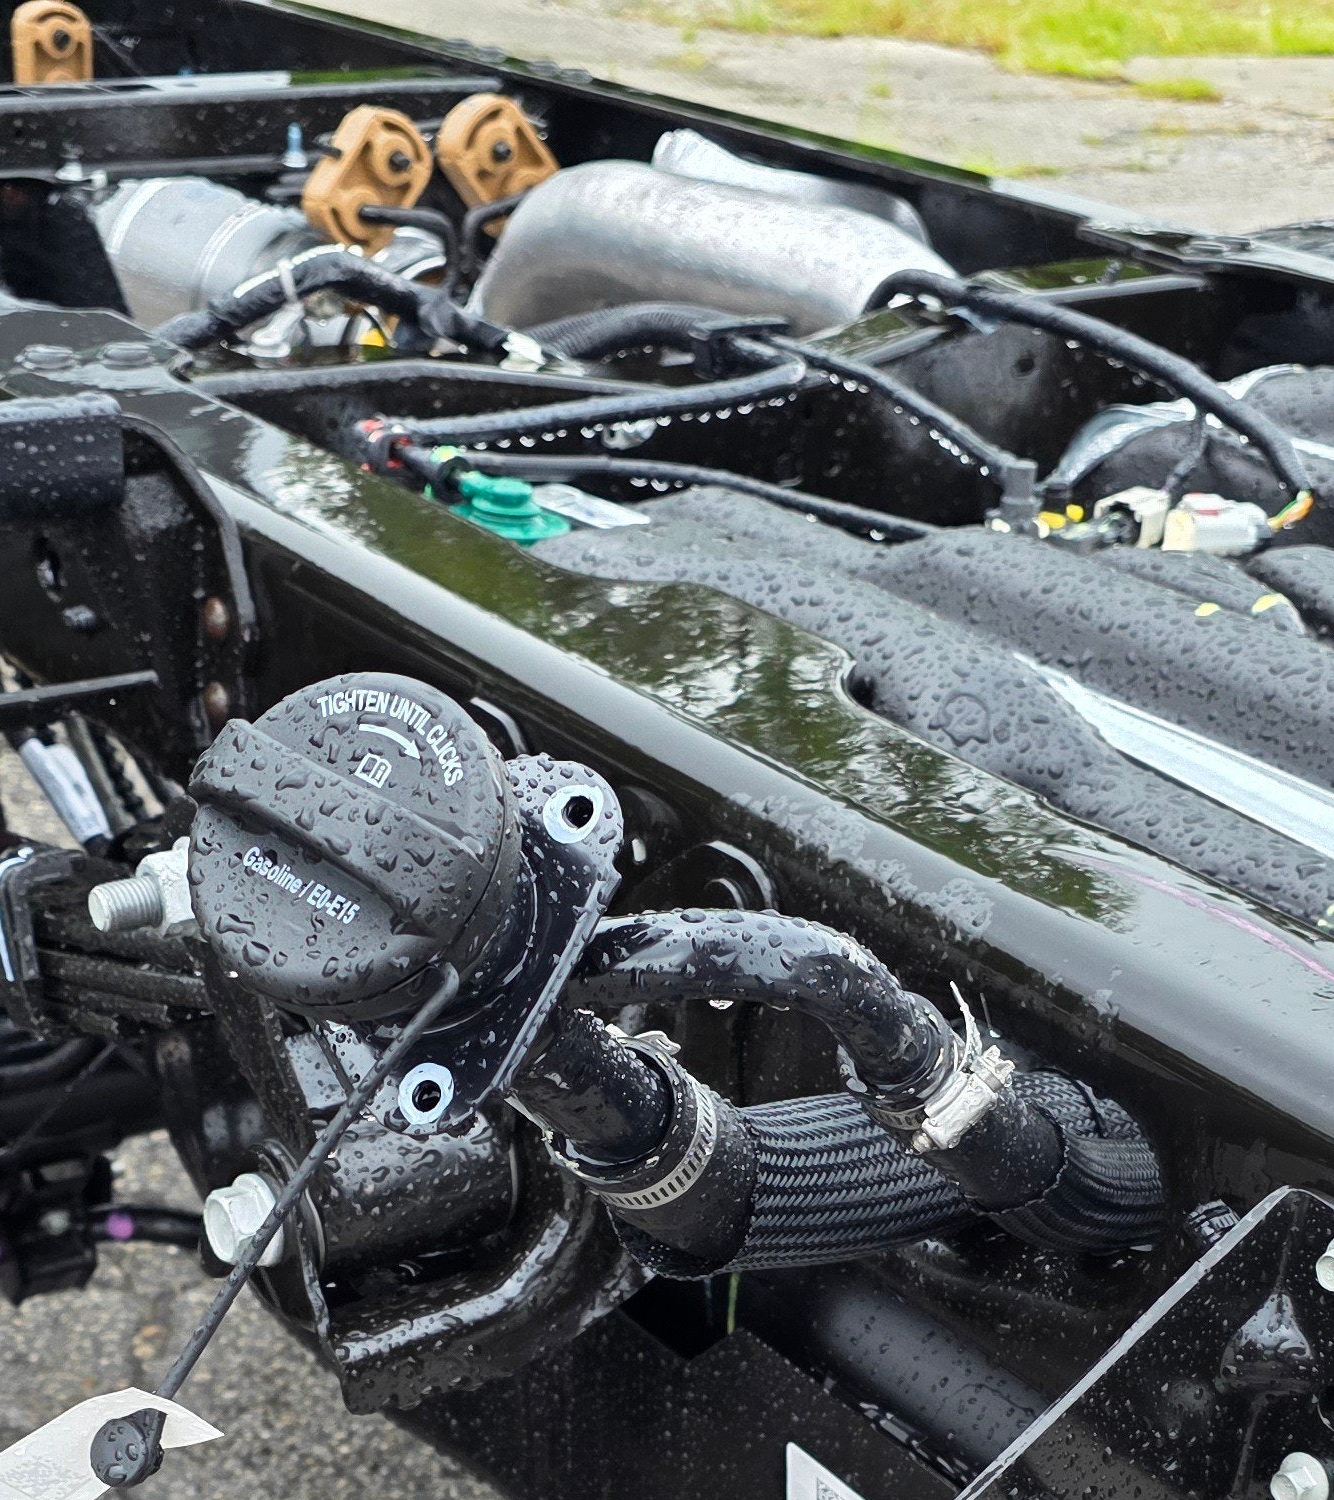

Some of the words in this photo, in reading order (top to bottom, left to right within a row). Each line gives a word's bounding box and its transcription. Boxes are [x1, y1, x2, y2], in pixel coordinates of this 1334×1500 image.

[316, 689, 391, 718] TIGHTEN
[389, 695, 432, 736] UNTIL
[425, 724, 464, 787] CLICKS
[242, 846, 303, 894] Gasoline
[306, 883, 361, 925] E0-E15
